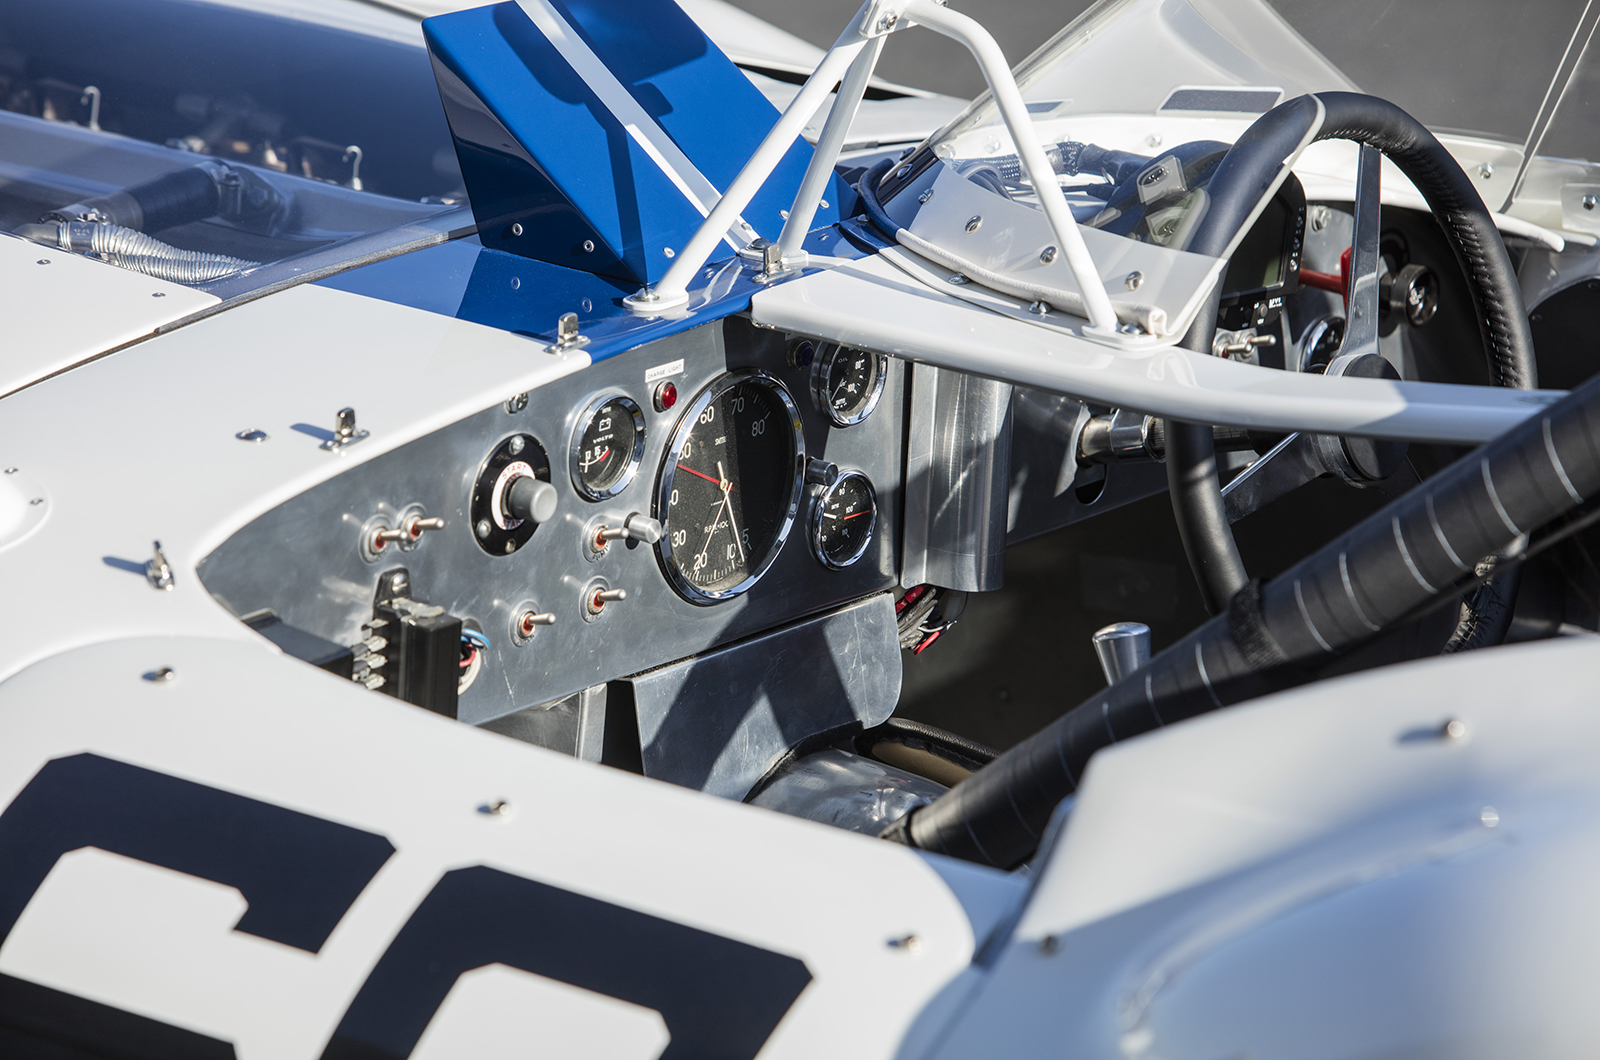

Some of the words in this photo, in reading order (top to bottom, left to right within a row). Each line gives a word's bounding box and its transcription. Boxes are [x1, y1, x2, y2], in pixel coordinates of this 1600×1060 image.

[647, 369, 665, 379] CHARGE
[668, 363, 682, 373] LIGHT
[731, 396, 745, 415] 70
[700, 405, 715, 425] 60
[751, 418, 765, 437] 80
[592, 433, 614, 444] VOLTS
[502, 463, 527, 480] START
[671, 529, 687, 548] 30
[742, 527, 750, 544] 5
[726, 543, 737, 560] 10
[693, 552, 708, 570] 20
